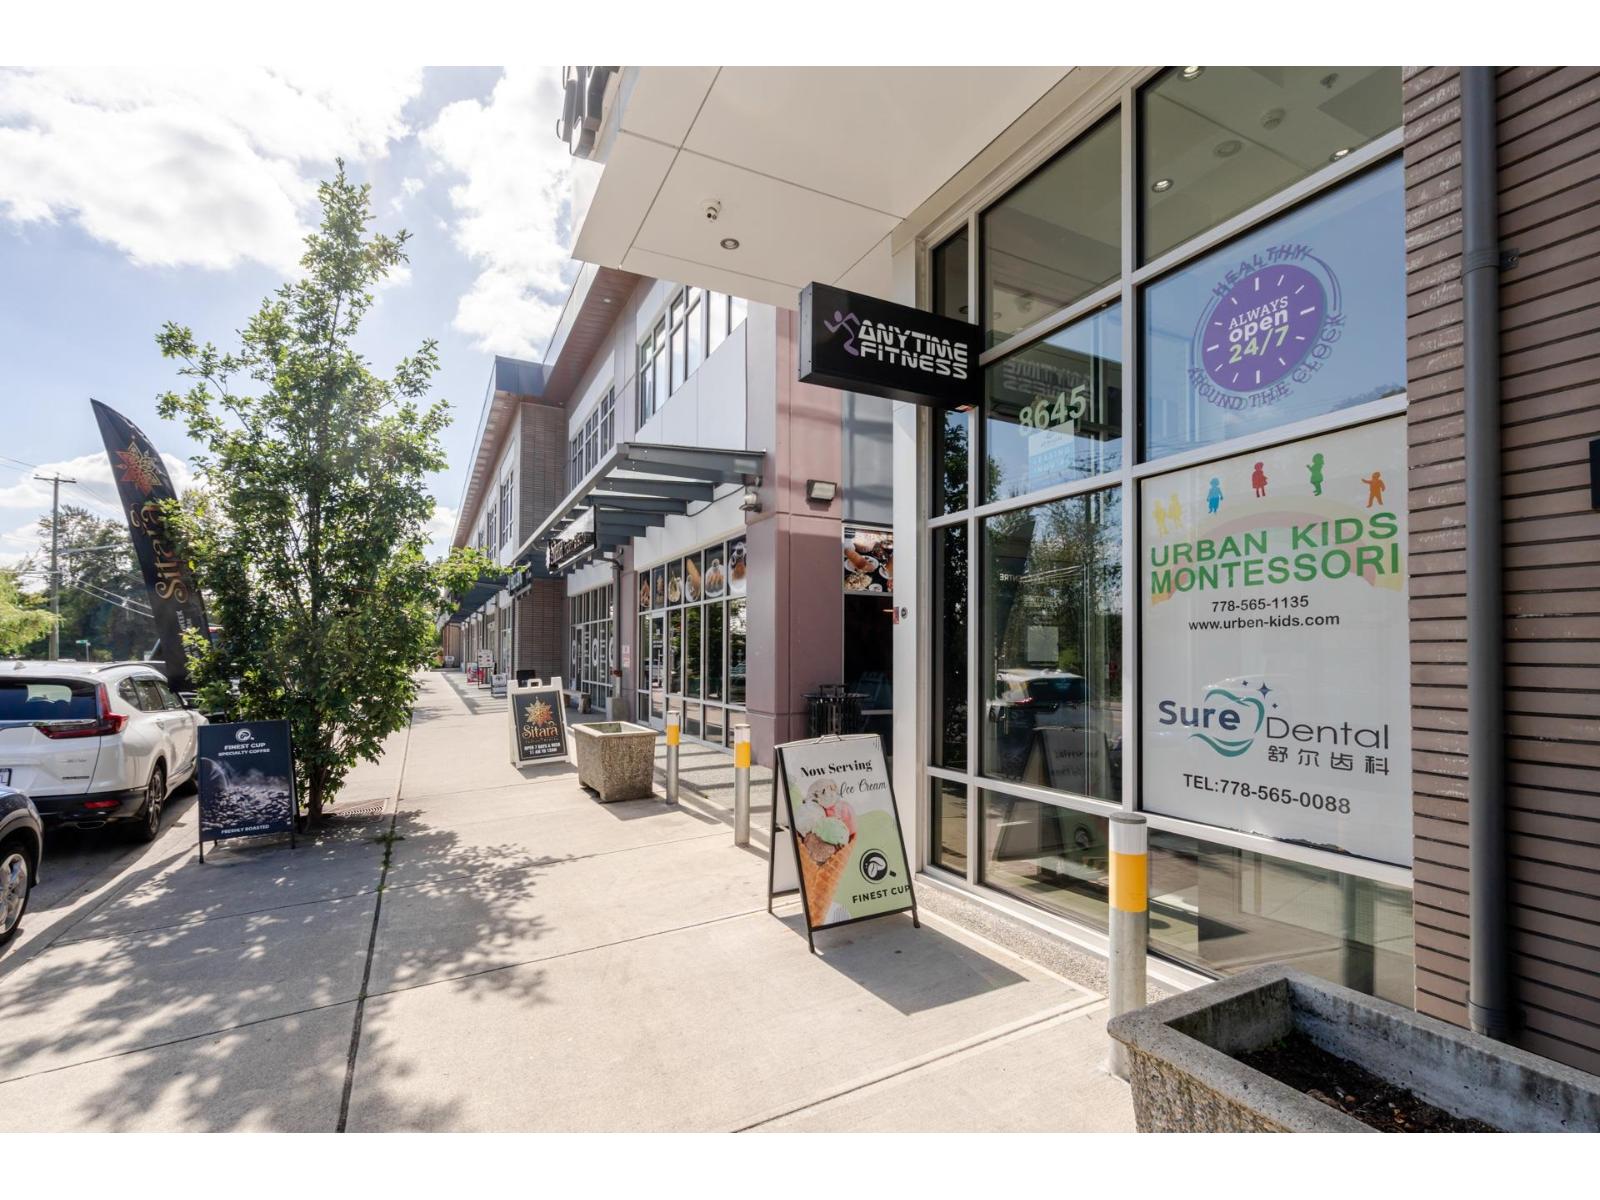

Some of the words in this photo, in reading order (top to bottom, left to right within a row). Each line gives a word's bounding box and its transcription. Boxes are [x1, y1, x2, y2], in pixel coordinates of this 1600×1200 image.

[1228, 296, 1289, 330] ALWAYS
[1229, 309, 1288, 343] open
[858, 319, 968, 364] ANYTIME
[1228, 325, 1289, 364] 24/7
[860, 342, 968, 380] FITNESS
[1188, 367, 1246, 411] AROUND
[1249, 381, 1292, 409] THE
[1292, 313, 1345, 384] CLOCK
[1019, 384, 1087, 435] 8645
[1151, 531, 1267, 567] URBAN
[1292, 512, 1398, 550] KIDS
[1151, 542, 1399, 594] MONTESSORI
[1211, 595, 1309, 613] 778-565-1135
[1188, 614, 1340, 631] www.urben-kids.com
[522, 721, 559, 738] Sitara
[1158, 700, 1240, 731] Sure
[1266, 717, 1389, 750] Dental
[224, 743, 250, 751] FINEST
[1268, 745, 1389, 776] 舒尔齿科
[800, 767, 826, 777] Now
[828, 760, 873, 774] Serving
[858, 778, 887, 793] Cream
[1183, 773, 1351, 814] TEL:778-565-0088
[852, 889, 888, 904] FINEST
